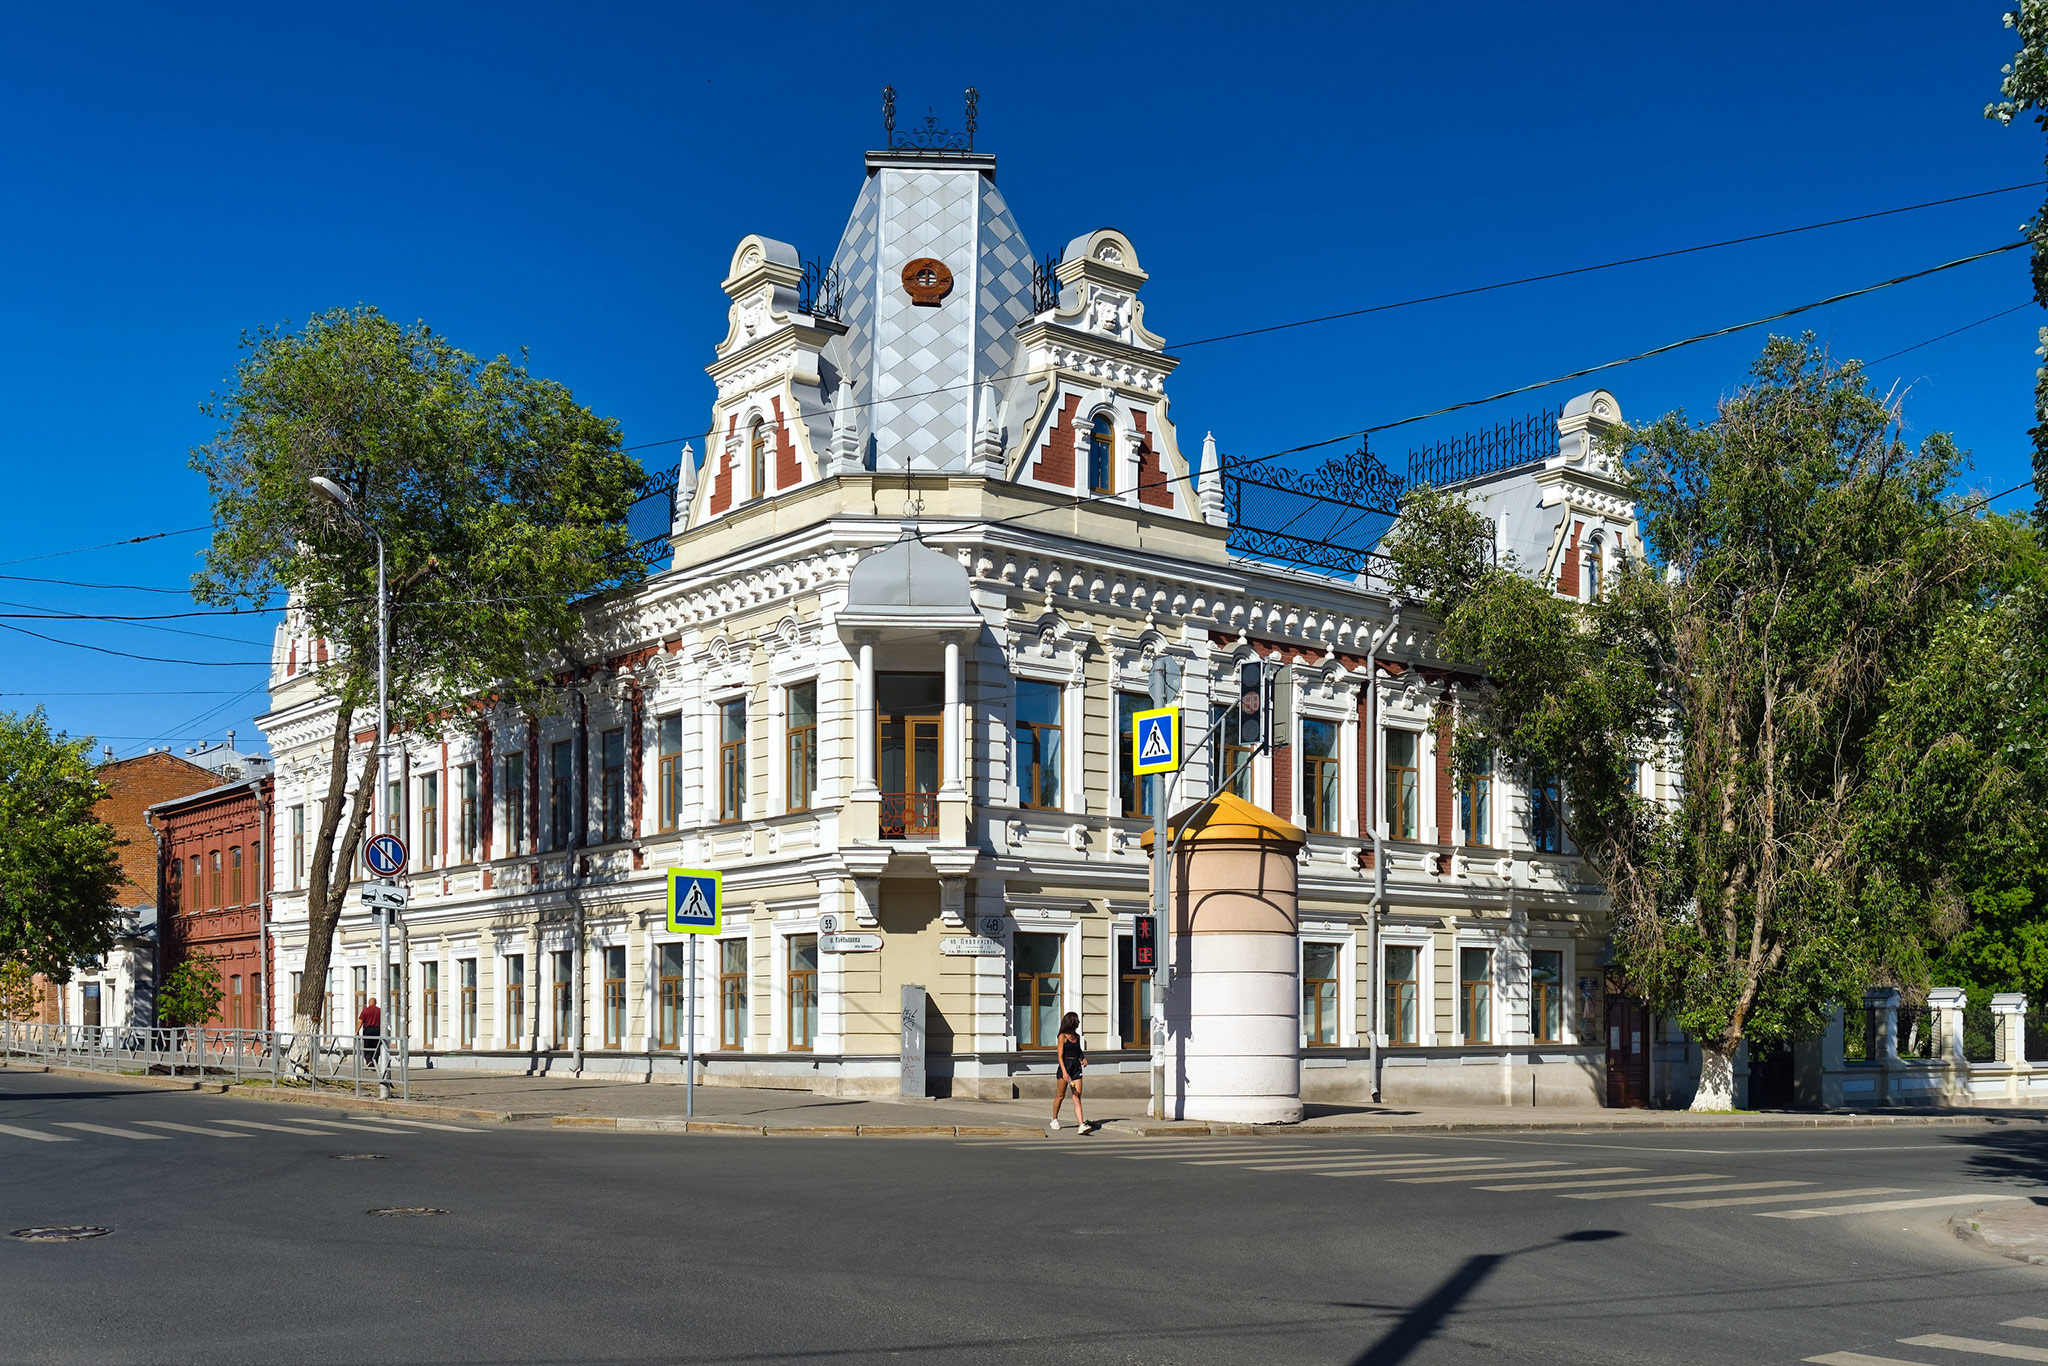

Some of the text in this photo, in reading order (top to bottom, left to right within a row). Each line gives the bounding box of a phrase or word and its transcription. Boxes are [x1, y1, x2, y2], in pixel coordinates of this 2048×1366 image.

[825, 919, 832, 929] 55
[986, 919, 999, 931] 48
[1138, 947, 1153, 963] 02
